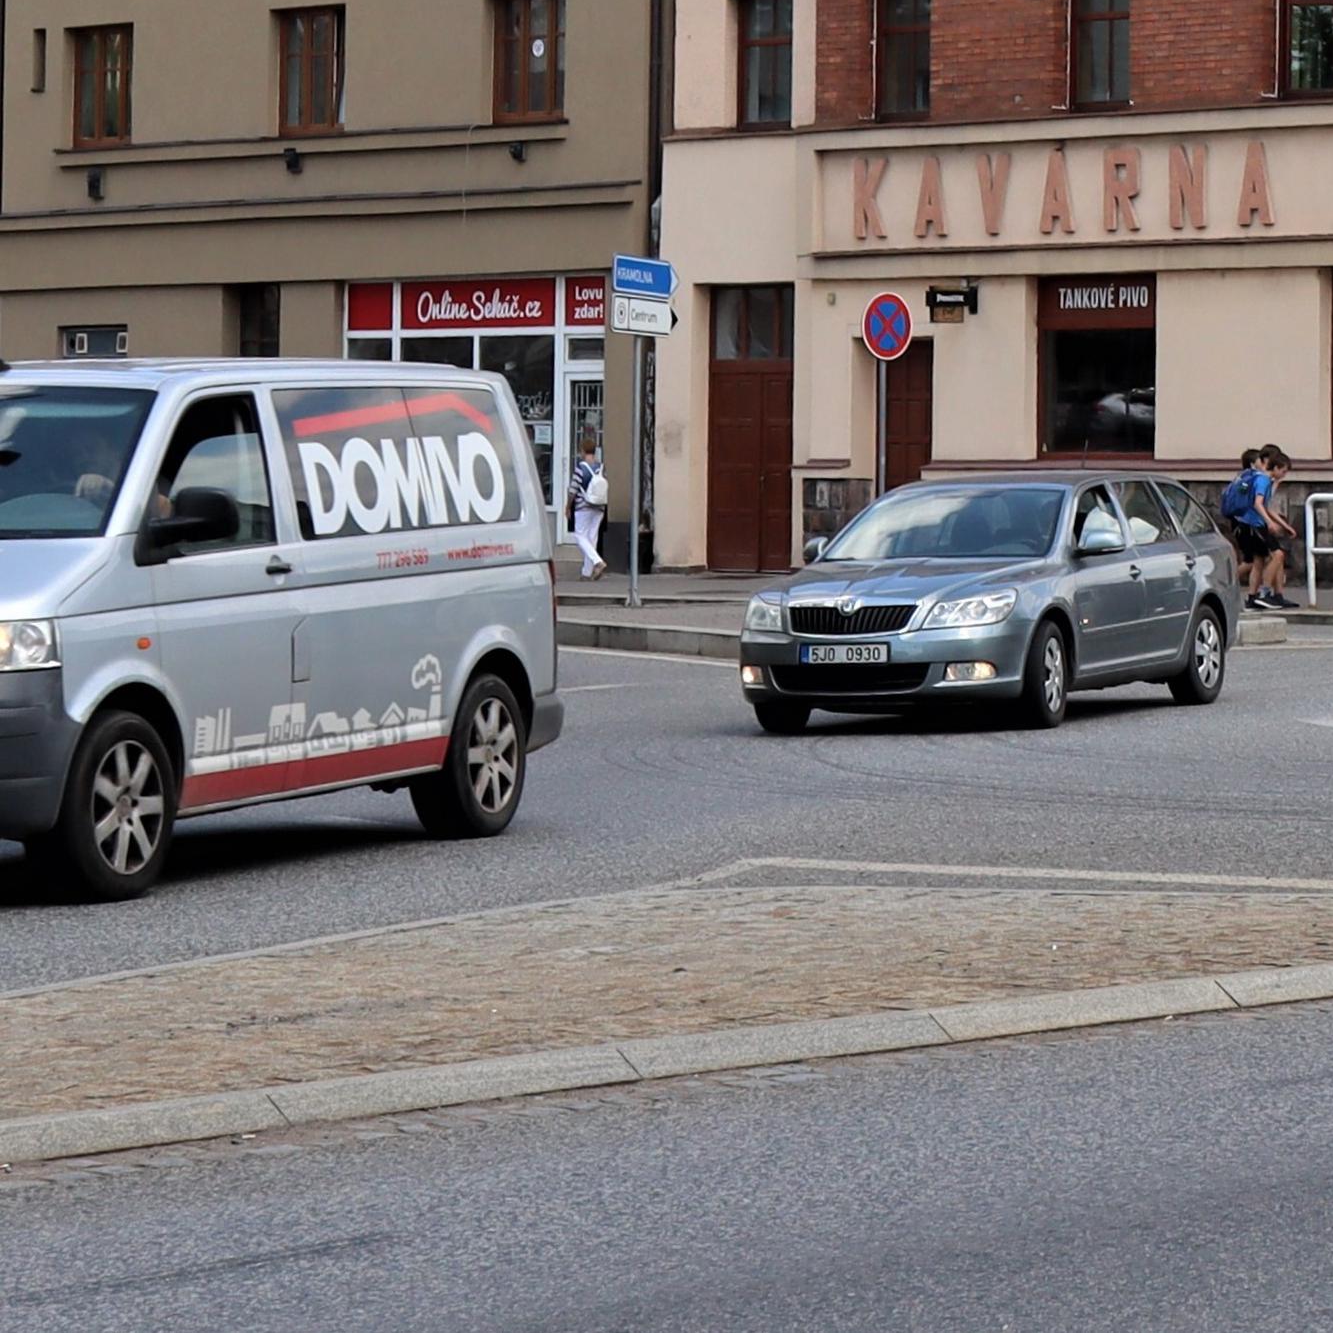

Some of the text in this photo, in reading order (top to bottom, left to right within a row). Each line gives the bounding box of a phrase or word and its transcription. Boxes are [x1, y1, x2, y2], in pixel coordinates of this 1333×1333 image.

[575, 285, 603, 301] Lovu
[1058, 282, 1149, 309] TANKOVÉ PIVO
[574, 303, 603, 319] zdar!
[631, 308, 658, 324] Centrum
[846, 647, 881, 661] 0930
